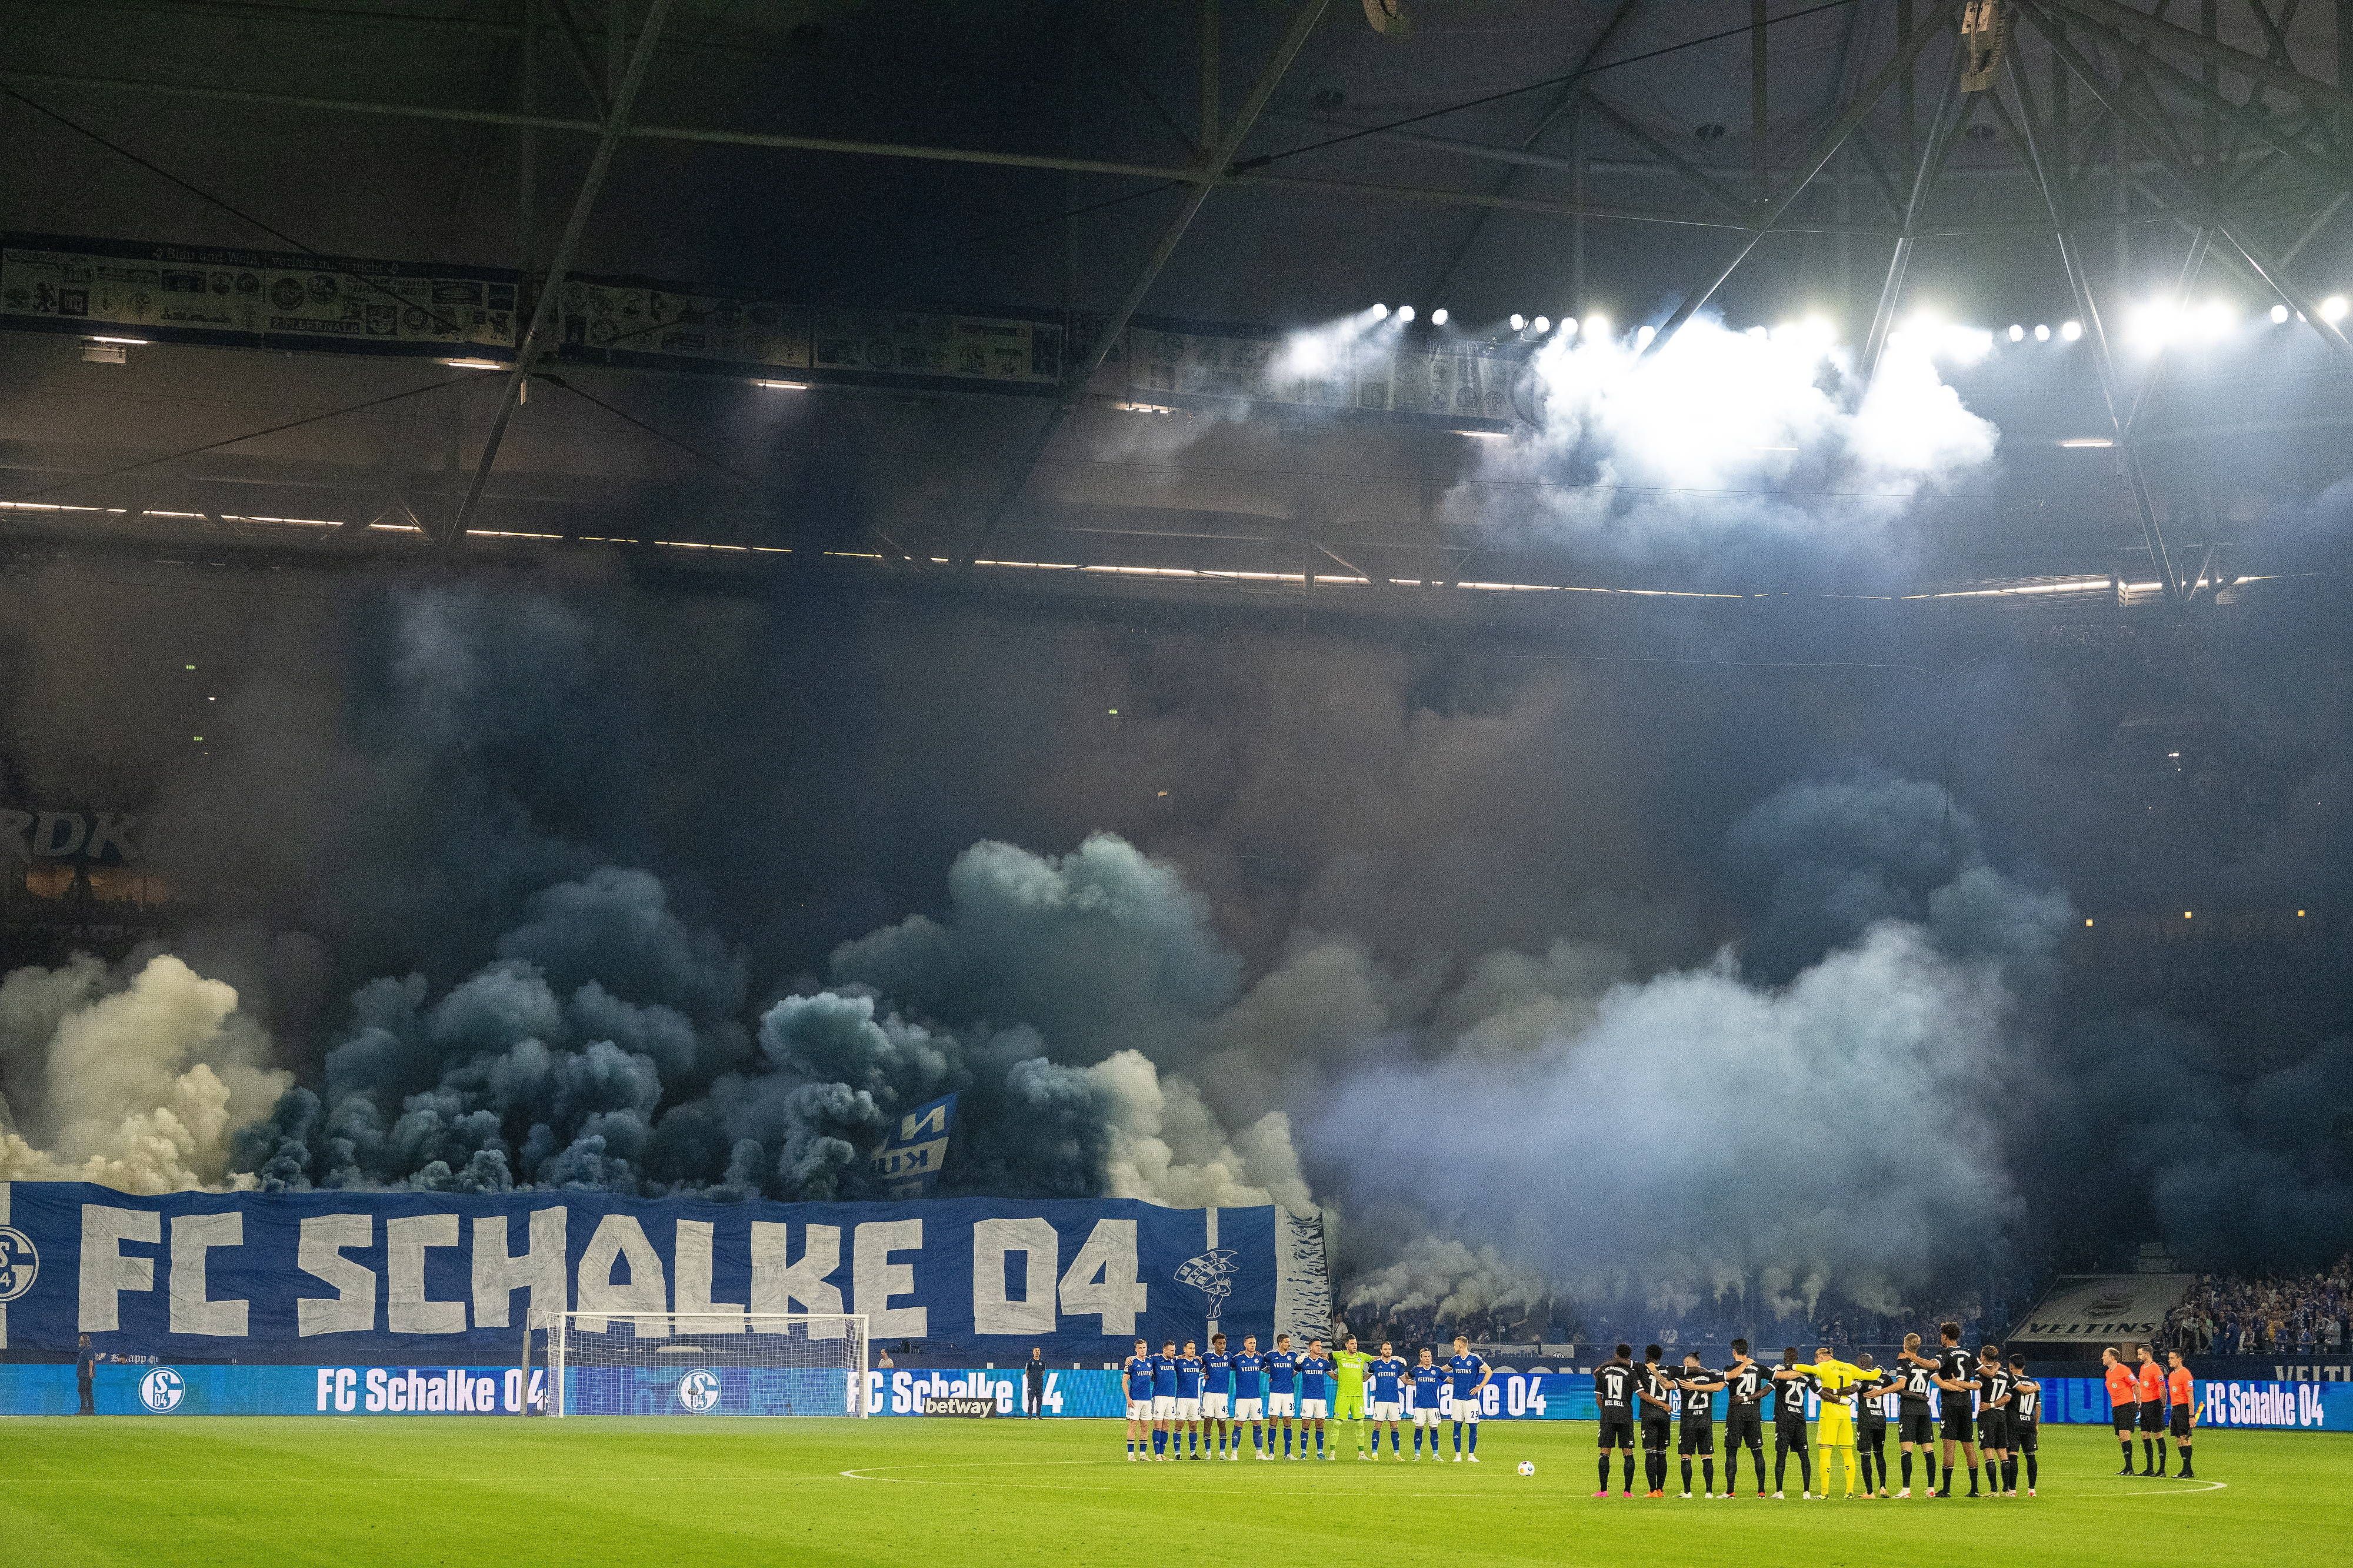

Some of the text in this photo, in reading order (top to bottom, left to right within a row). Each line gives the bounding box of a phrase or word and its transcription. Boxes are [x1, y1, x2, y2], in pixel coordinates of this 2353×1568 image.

[167, 247, 195, 260] Blau
[199, 251, 224, 262] und
[0, 1272, 12, 1287] 4
[78, 1203, 1148, 1340] FC SCHALKE 04
[2028, 1323, 2155, 1333] VELTINS
[1957, 1357, 1965, 1381] 5
[316, 1367, 549, 1412] FC Schalke 04
[1022, 1372, 1064, 1413] 4
[1507, 1375, 1547, 1416] 04
[1605, 1374, 1624, 1400] 19
[1785, 1380, 1807, 1407] 25
[1989, 1378, 2007, 1402] 17
[925, 1398, 993, 1419] betway
[2019, 1392, 2035, 1415] 10
[2205, 1382, 2324, 1426] FC Schalke 04
